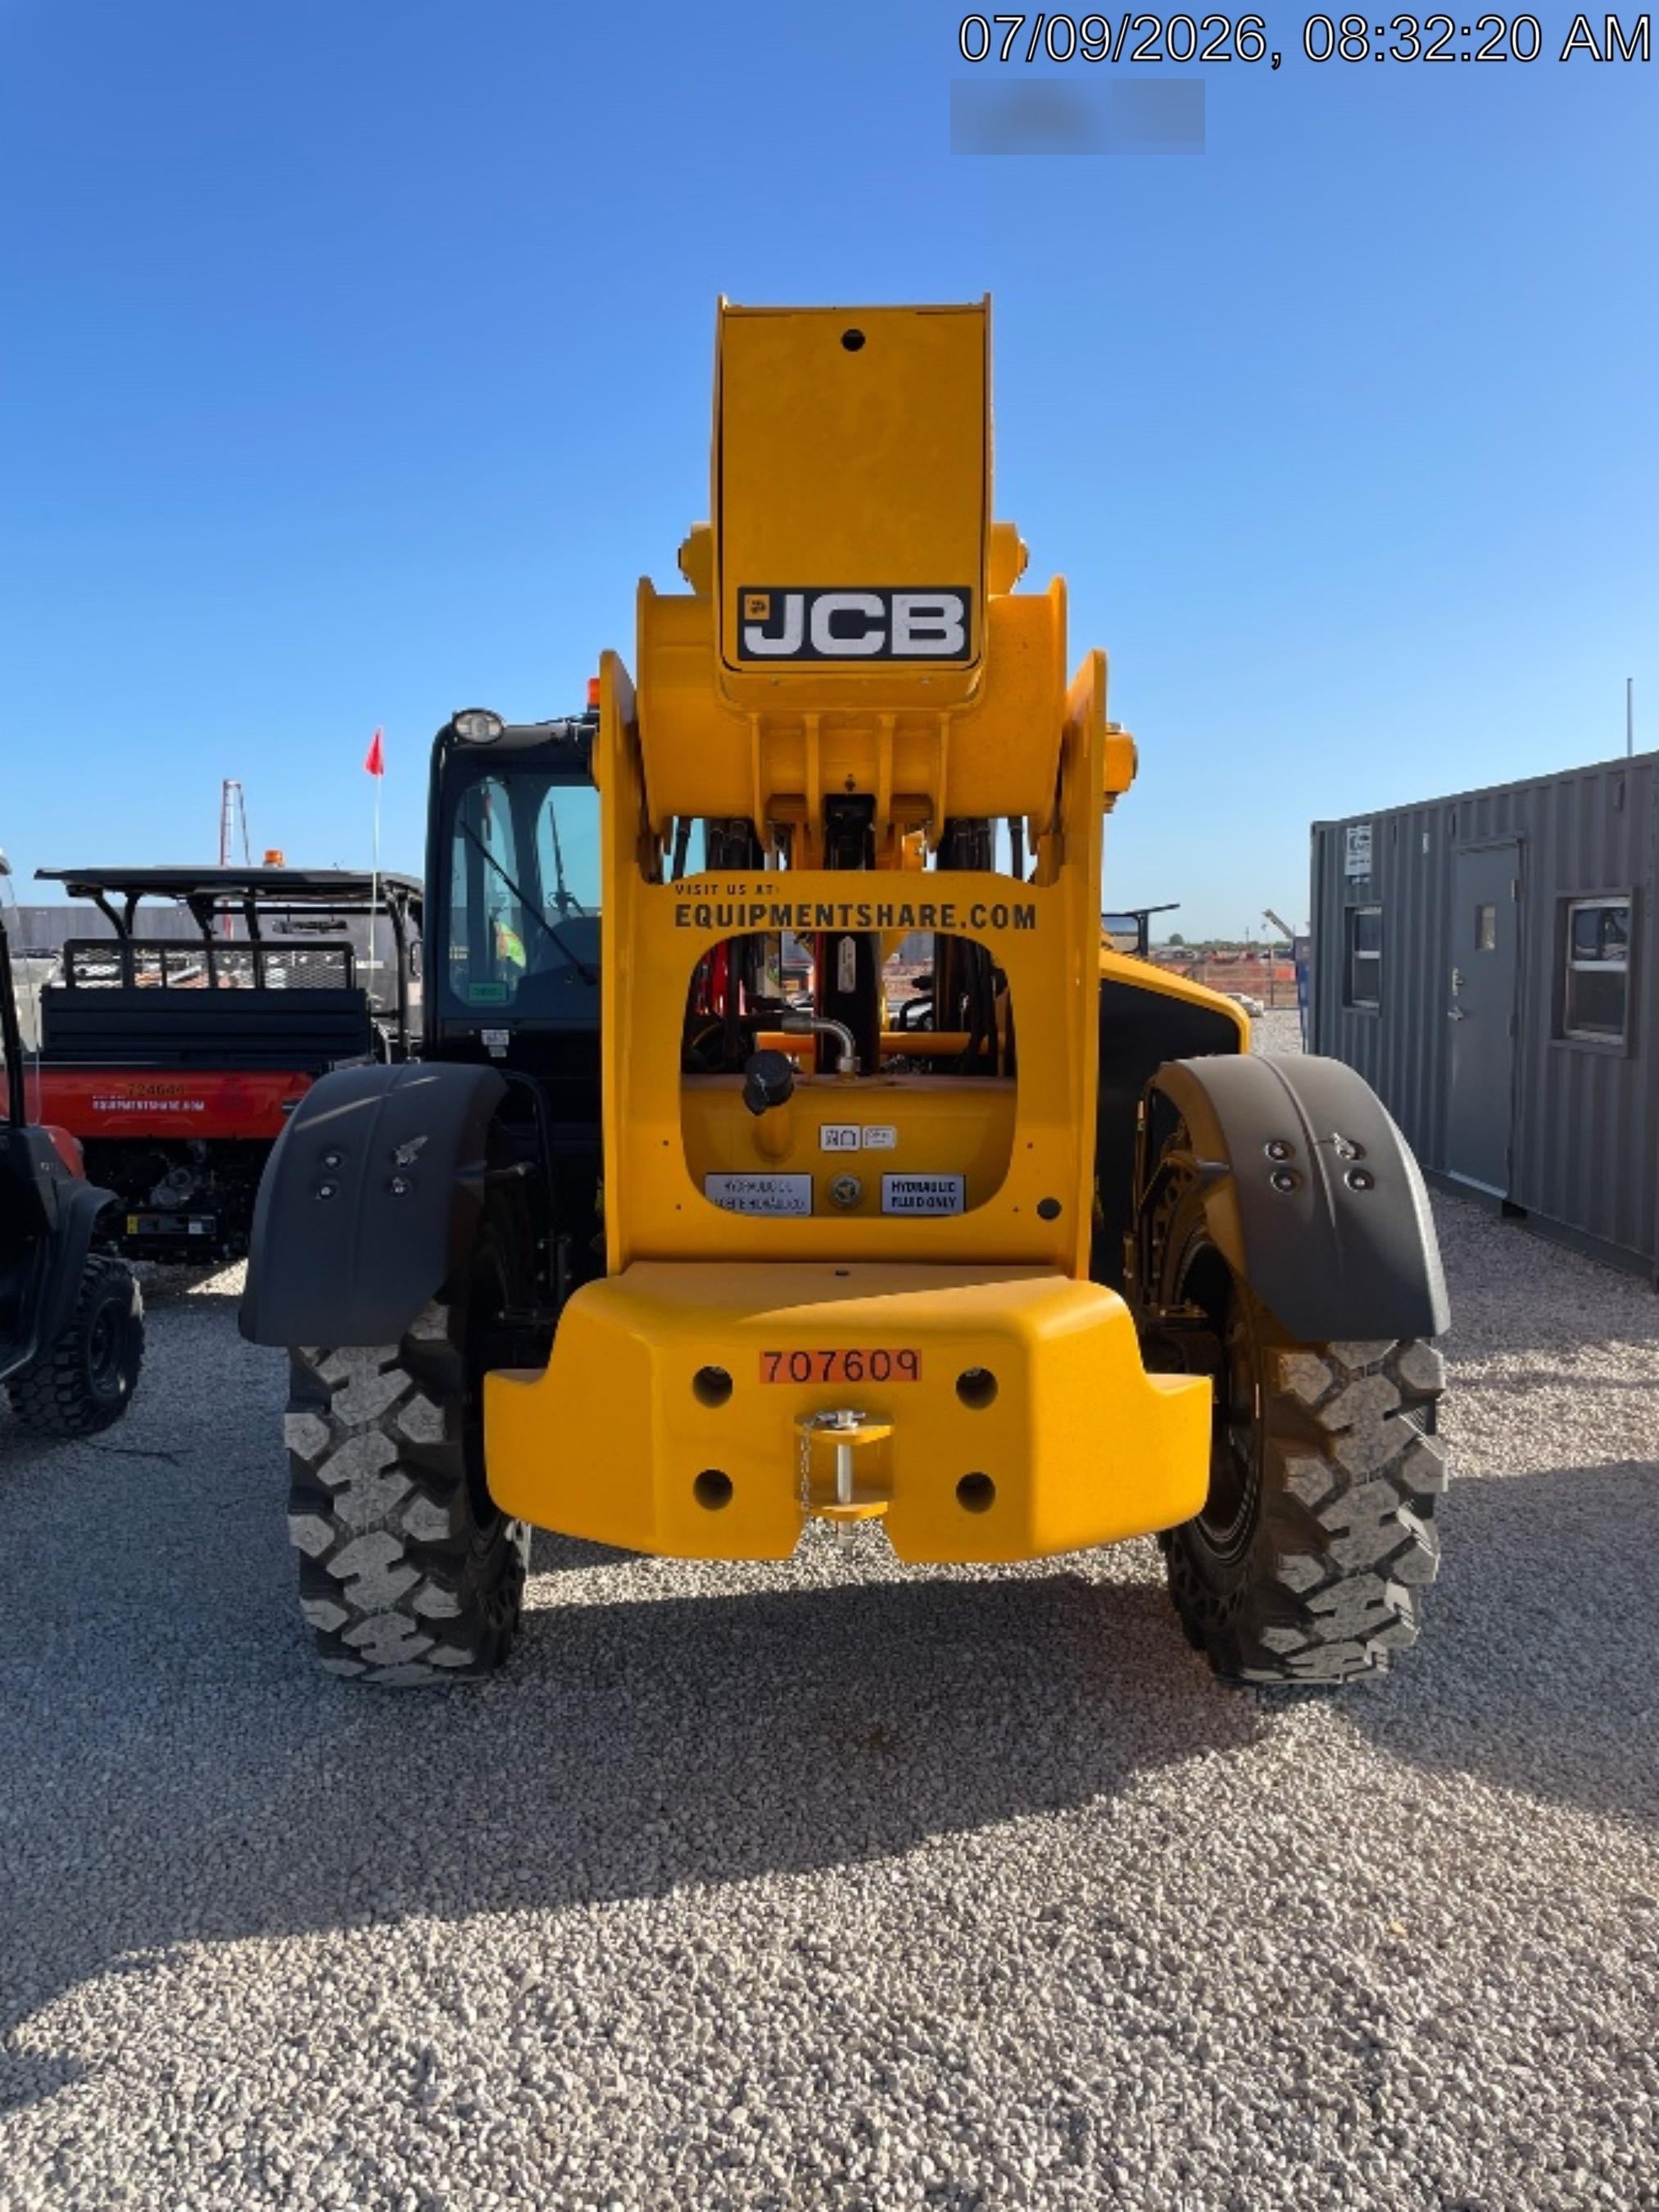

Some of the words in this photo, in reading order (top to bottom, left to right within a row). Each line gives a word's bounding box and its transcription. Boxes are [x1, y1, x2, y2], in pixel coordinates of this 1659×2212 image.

[744, 594, 965, 655] JCB
[675, 884, 718, 895] VISIT
[727, 884, 746, 895] US
[675, 904, 1036, 929] EQUIPMENTSHARE.COM
[891, 1181, 956, 1193] HYDRAULIC
[891, 1196, 925, 1208] FLUID
[927, 1196, 958, 1208] ONLY
[764, 1349, 918, 1382] 707609
